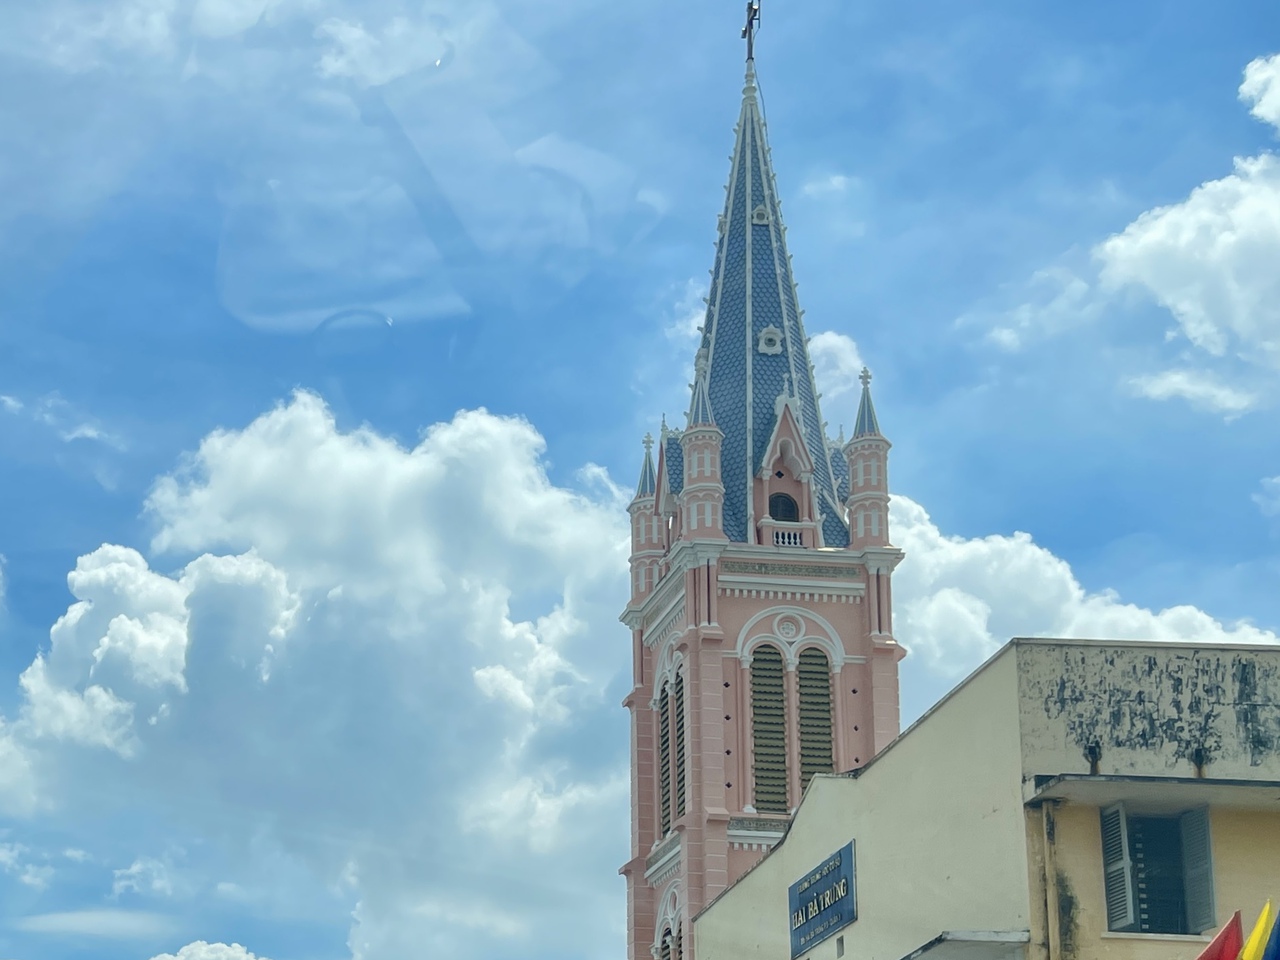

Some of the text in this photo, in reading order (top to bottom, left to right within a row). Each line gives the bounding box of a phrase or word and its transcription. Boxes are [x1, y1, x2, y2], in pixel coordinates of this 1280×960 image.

[792, 878, 847, 930] HAI BÀ TRƯNG
